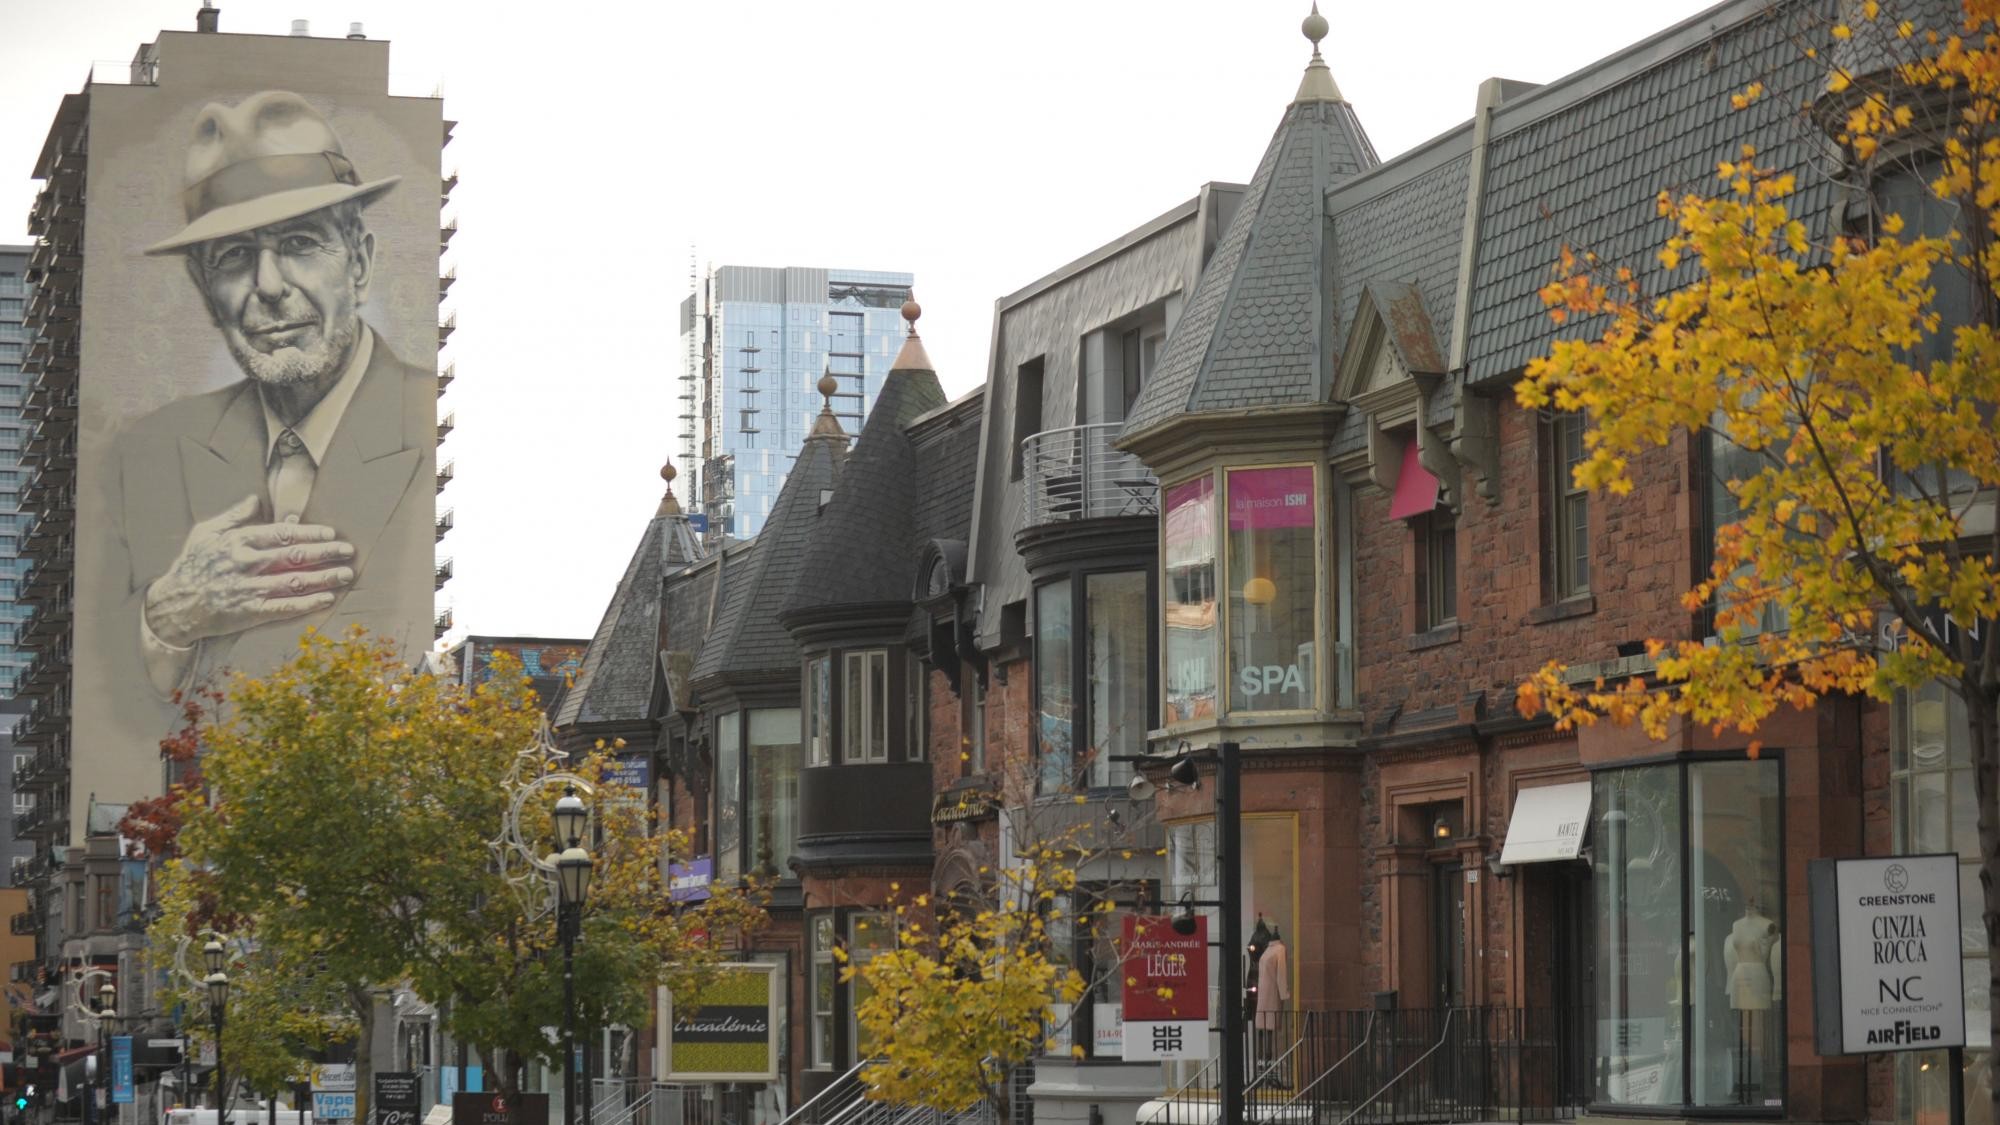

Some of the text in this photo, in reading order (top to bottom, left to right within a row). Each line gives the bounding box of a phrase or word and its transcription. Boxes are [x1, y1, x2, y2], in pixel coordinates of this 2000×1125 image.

[1247, 497, 1282, 509] maison
[1285, 492, 1307, 507] ISHI
[1240, 663, 1306, 696] SPA
[1858, 892, 1937, 907] CREENSTONE
[1872, 914, 1927, 940] CINZIA
[1873, 938, 1928, 965] ROCCA
[1147, 951, 1188, 977] LÉGER
[1878, 975, 1924, 1004] NC
[1860, 1007, 1880, 1016] NICE
[315, 1093, 354, 1107] Vape
[319, 1106, 350, 1118] Lion
